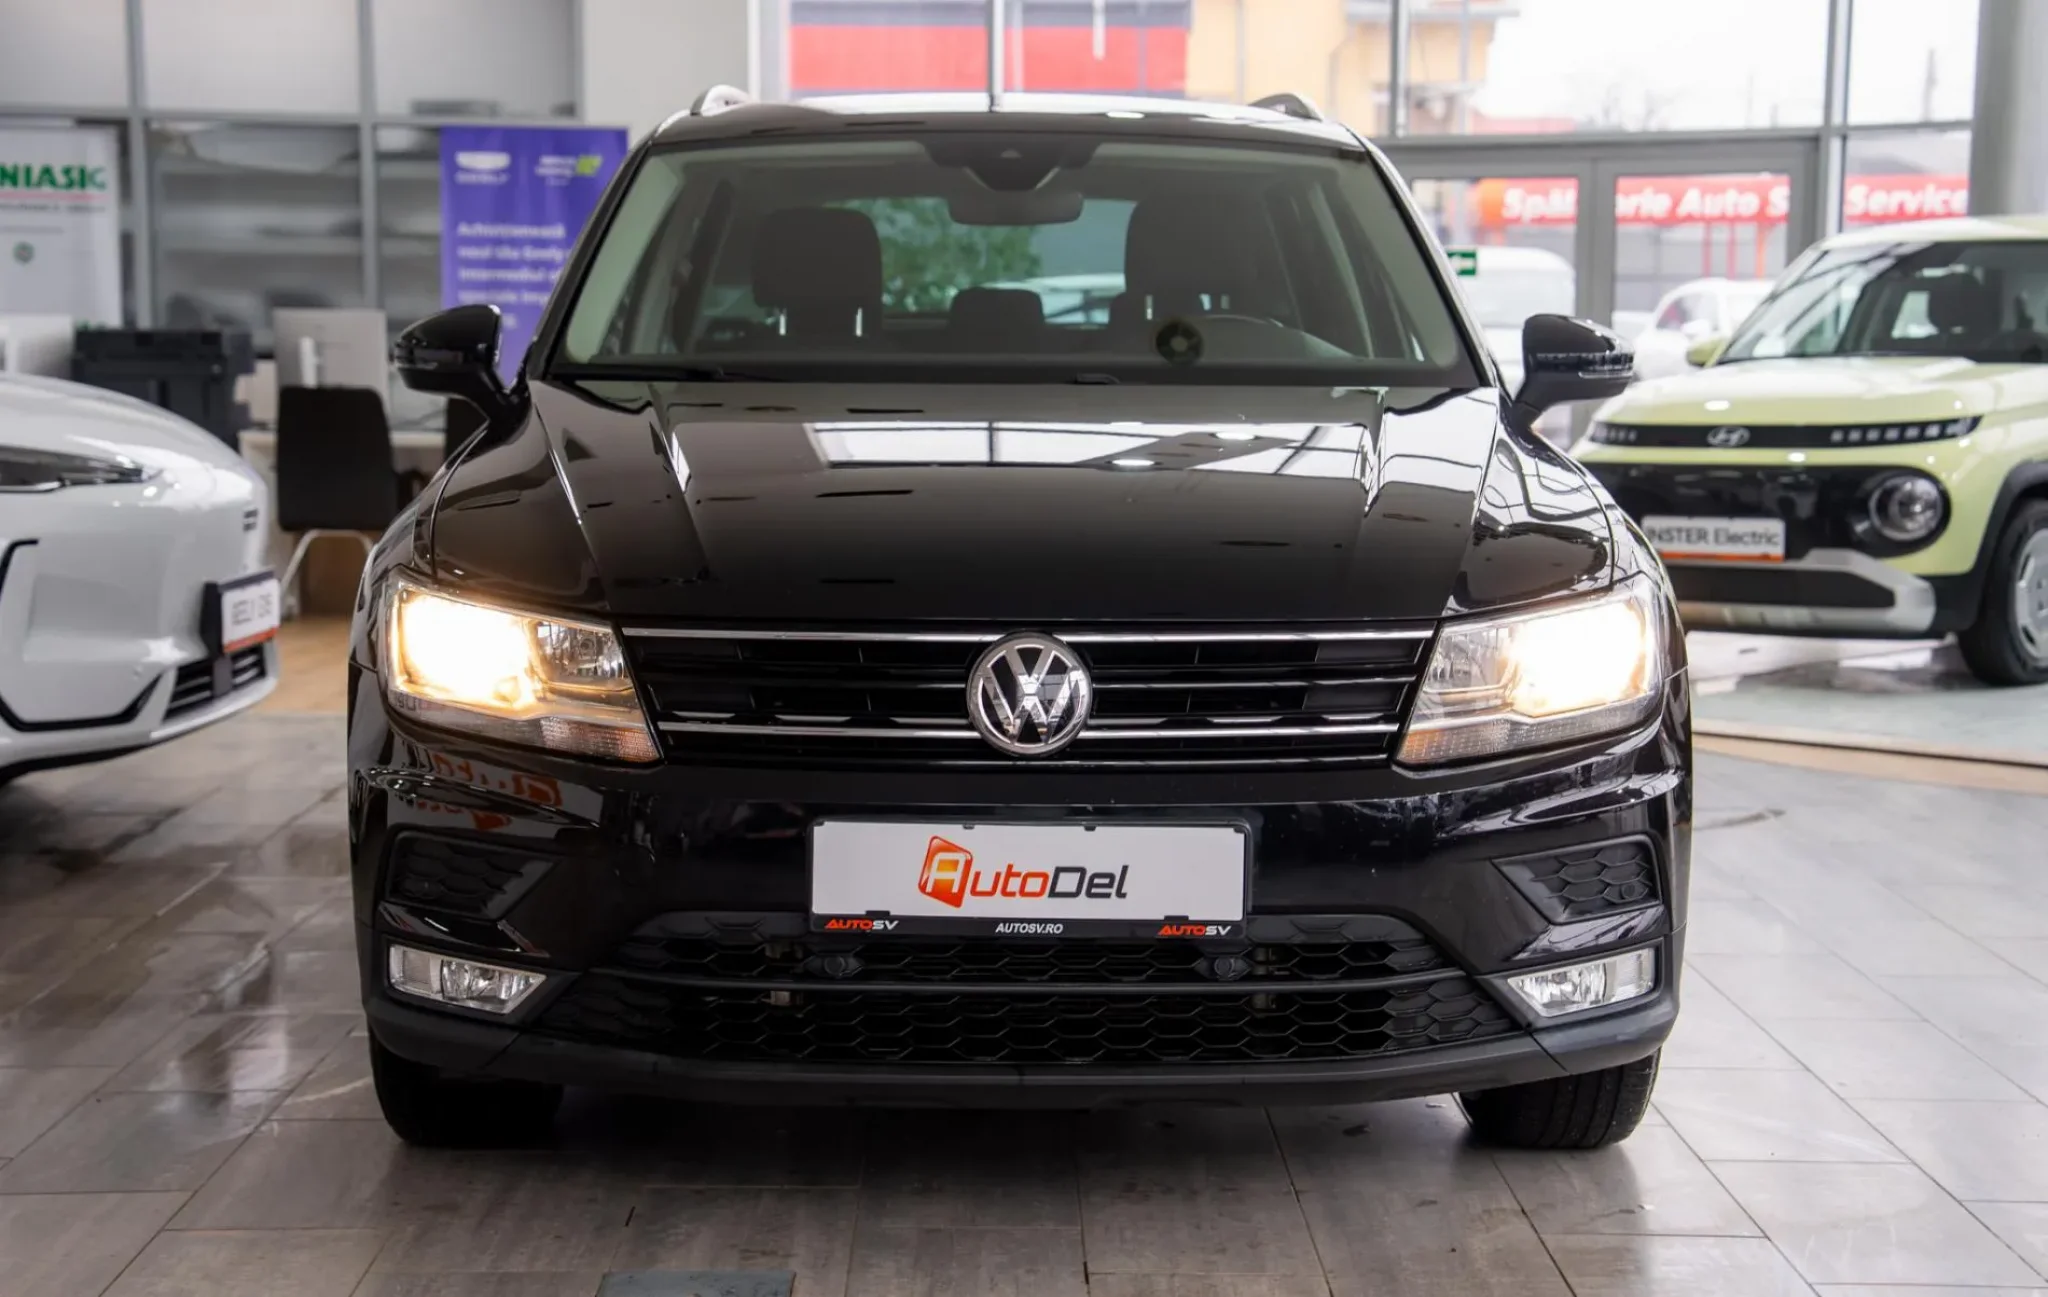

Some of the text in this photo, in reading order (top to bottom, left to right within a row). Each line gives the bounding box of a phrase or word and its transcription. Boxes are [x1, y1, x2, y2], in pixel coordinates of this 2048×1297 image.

[1676, 187, 1760, 219] Auto
[1714, 526, 1780, 546] Electric
[924, 849, 1129, 899] AutoDel
[825, 918, 899, 931] AUTOSV
[995, 922, 1064, 935] AUTOSV.RO
[1158, 924, 1232, 937] AUTOSV
